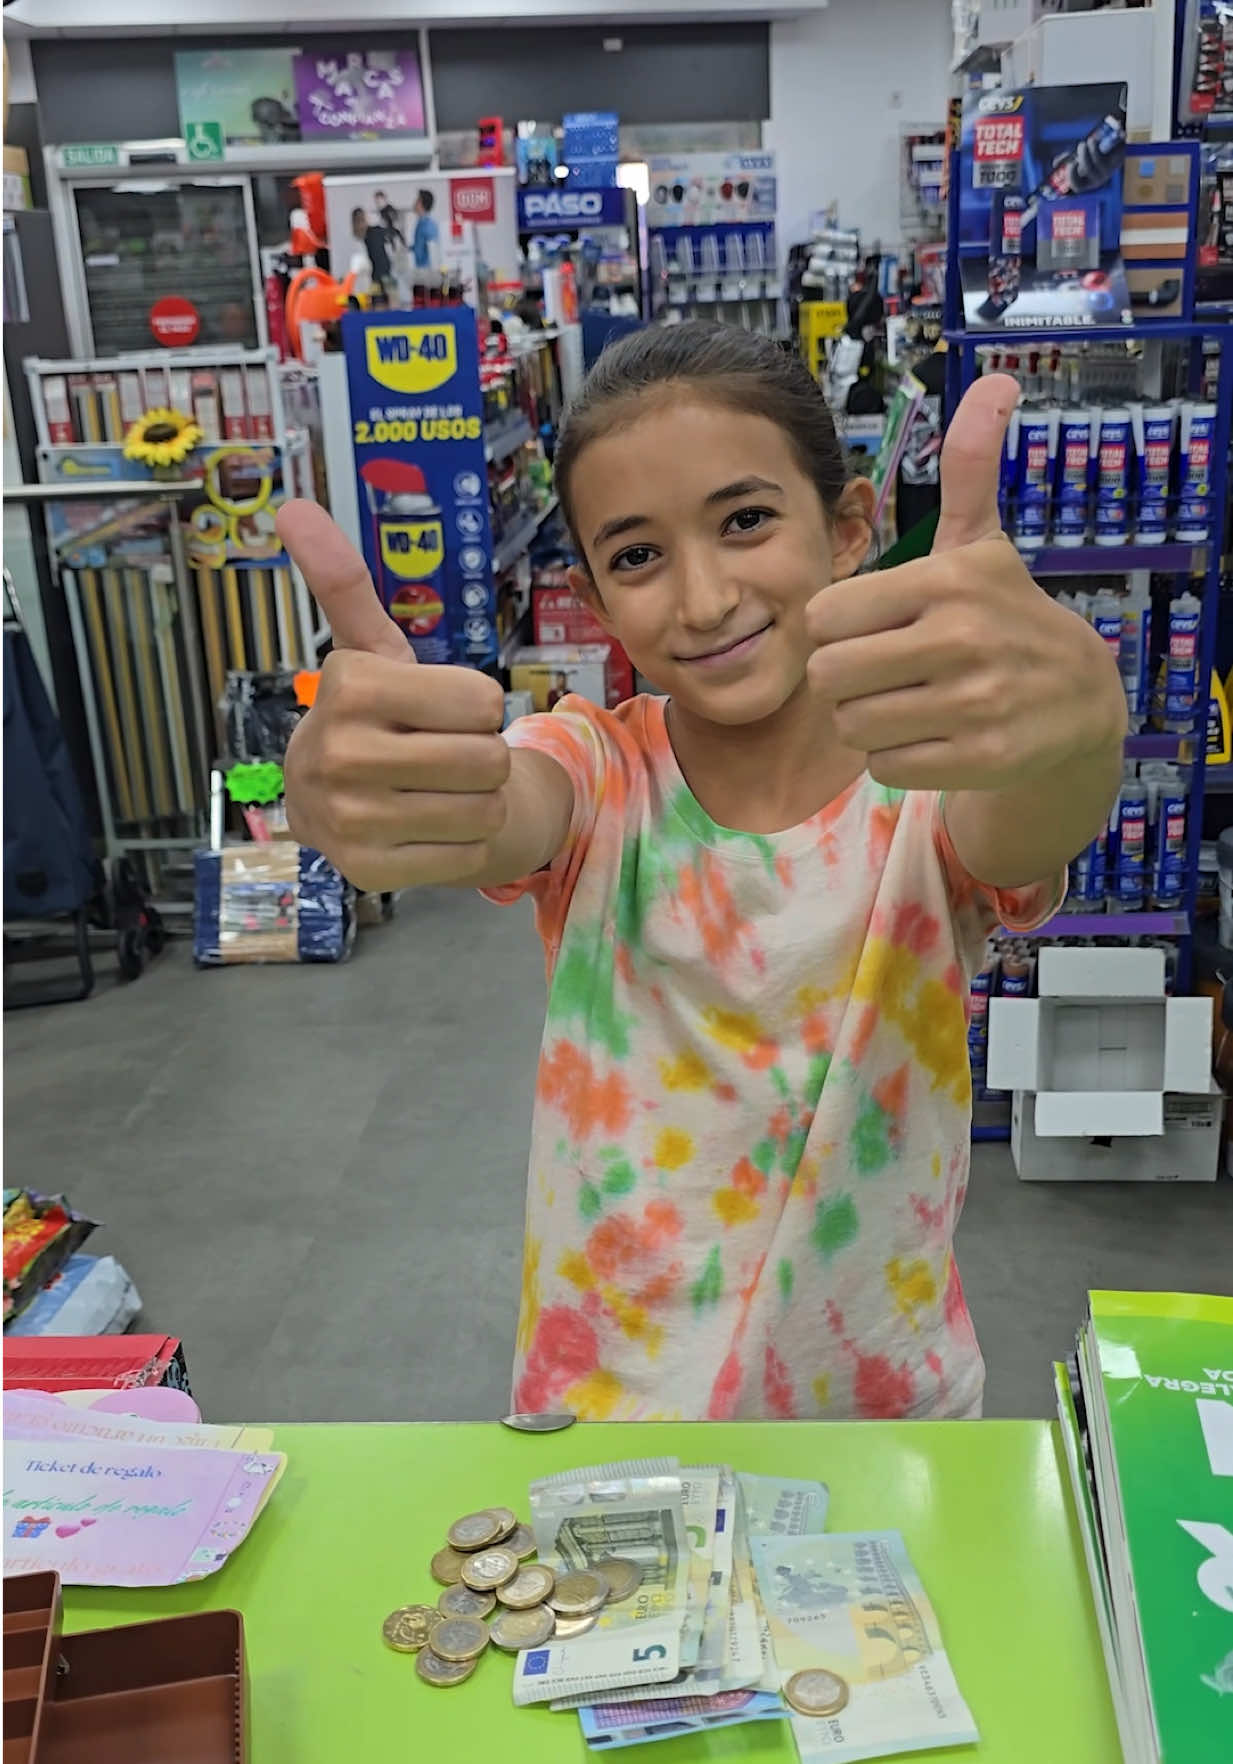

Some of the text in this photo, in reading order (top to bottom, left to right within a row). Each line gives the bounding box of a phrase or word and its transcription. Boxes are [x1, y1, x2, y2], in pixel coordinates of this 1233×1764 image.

[976, 123, 1023, 140] TOTAL
[977, 139, 1019, 156] TECH
[524, 191, 603, 218] PASO
[376, 333, 447, 363] WD-40
[355, 417, 481, 443] 2.000 USOS
[386, 530, 438, 554] WD-40
[1143, 1374, 1233, 1396] LEGRA
[26, 1459, 162, 1481] Ticket de regalo
[632, 1644, 667, 1662] 5
[828, 1719, 845, 1743] EURO
